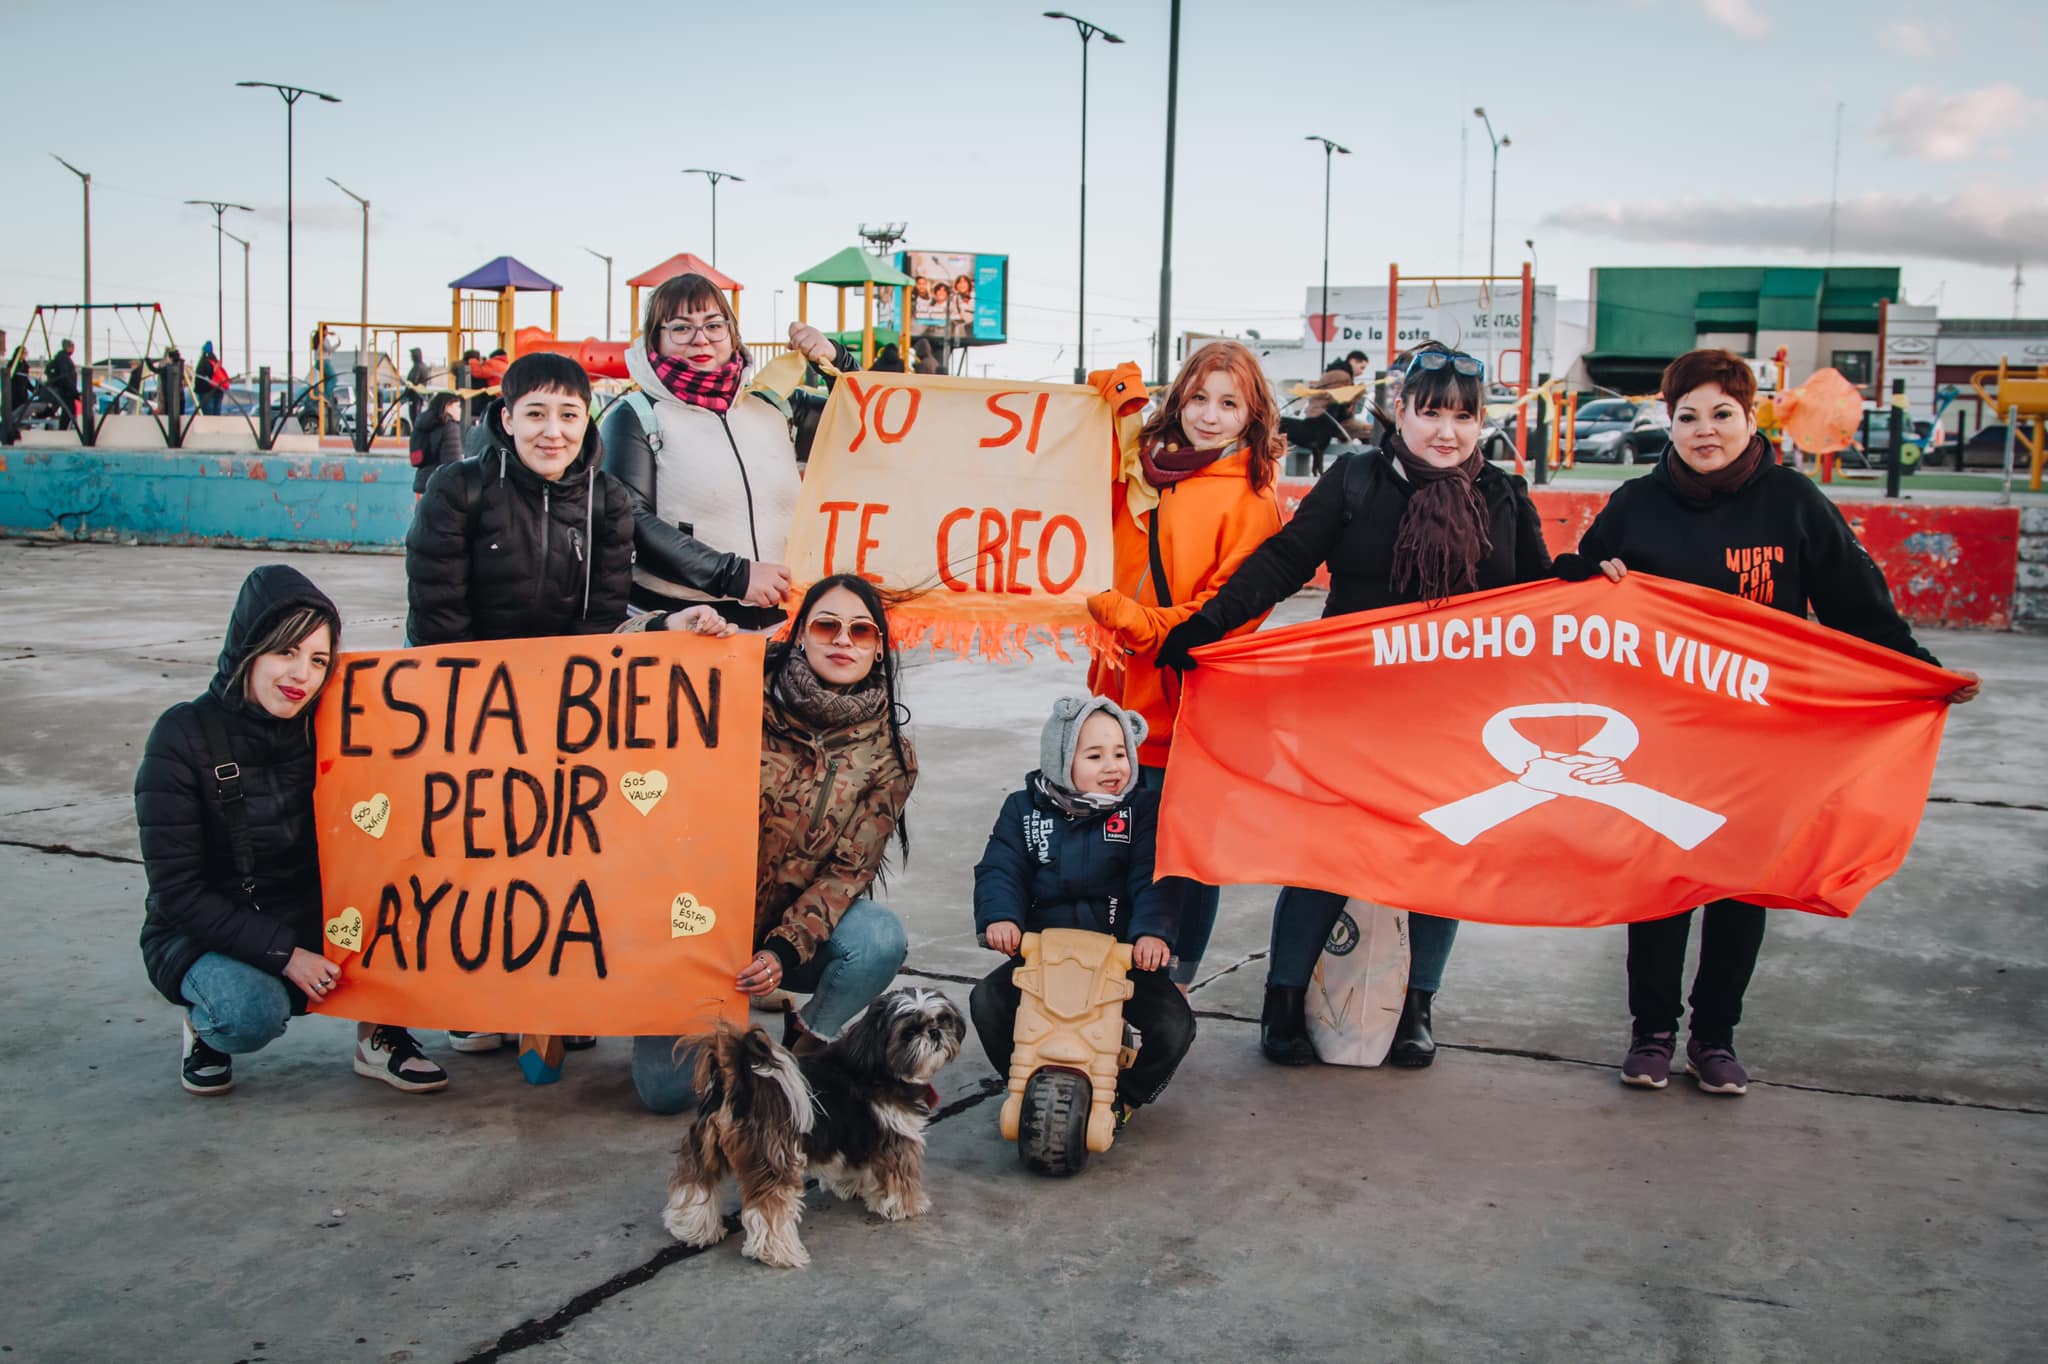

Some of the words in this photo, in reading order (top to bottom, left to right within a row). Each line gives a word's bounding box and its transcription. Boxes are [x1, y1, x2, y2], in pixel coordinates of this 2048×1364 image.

[1343, 328, 1361, 340] De
[1369, 327, 1383, 340] la
[1398, 328, 1430, 340] osta
[847, 377, 921, 453] YO
[979, 391, 1049, 454] SI
[819, 502, 889, 583] TE
[936, 507, 1087, 595] CREO
[1726, 546, 1784, 573] MUCHO
[1740, 561, 1771, 594] POR
[1372, 614, 1536, 666] MUCHO
[1552, 614, 1642, 667] POR
[1655, 631, 1771, 706] VIVIR
[340, 657, 528, 758] ESTA
[623, 777, 646, 788] SOS
[354, 807, 370, 822] SOS
[676, 896, 692, 908] NO
[362, 874, 608, 979] AYUDA
[679, 908, 707, 924] ESTAS
[327, 924, 339, 936] YO
